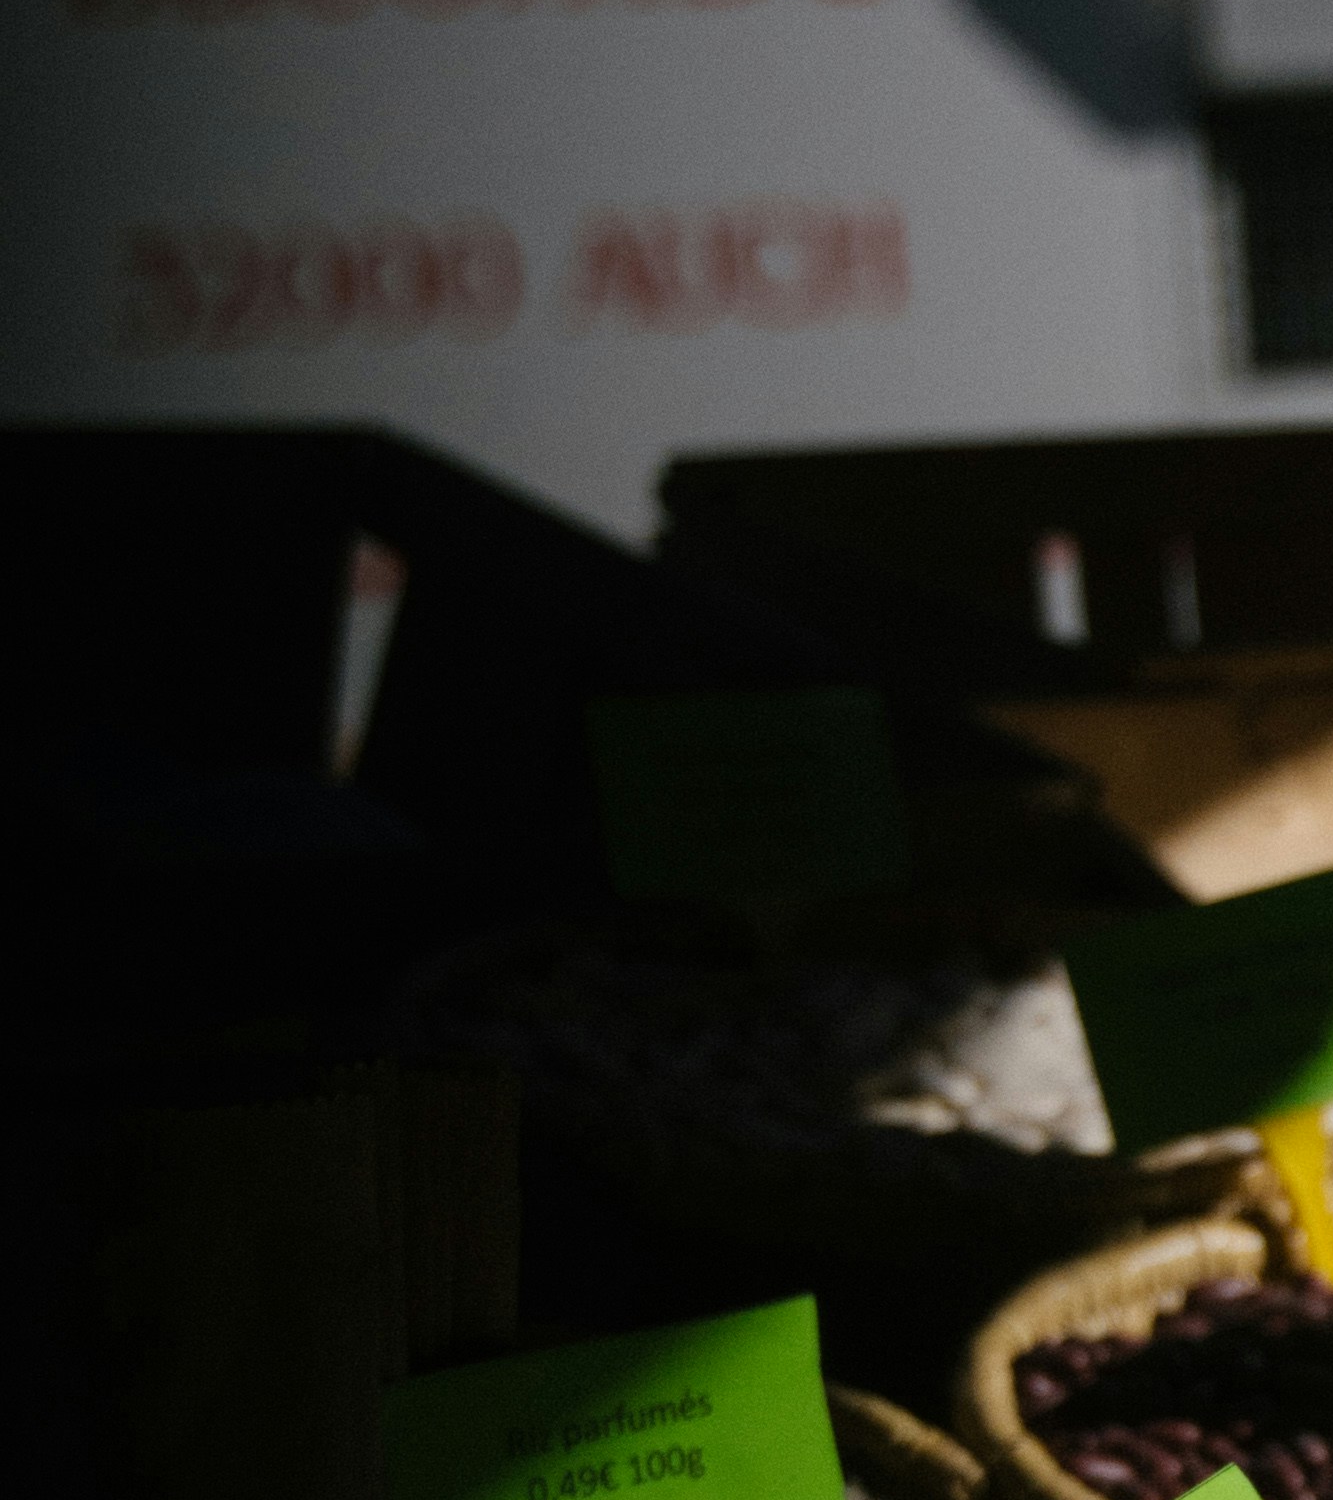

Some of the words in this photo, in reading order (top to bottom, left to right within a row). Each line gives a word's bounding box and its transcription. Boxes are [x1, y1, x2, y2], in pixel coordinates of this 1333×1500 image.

[572, 195, 915, 328] AUCH
[563, 1390, 713, 1453] parfumés
[629, 1445, 707, 1485] 100g
